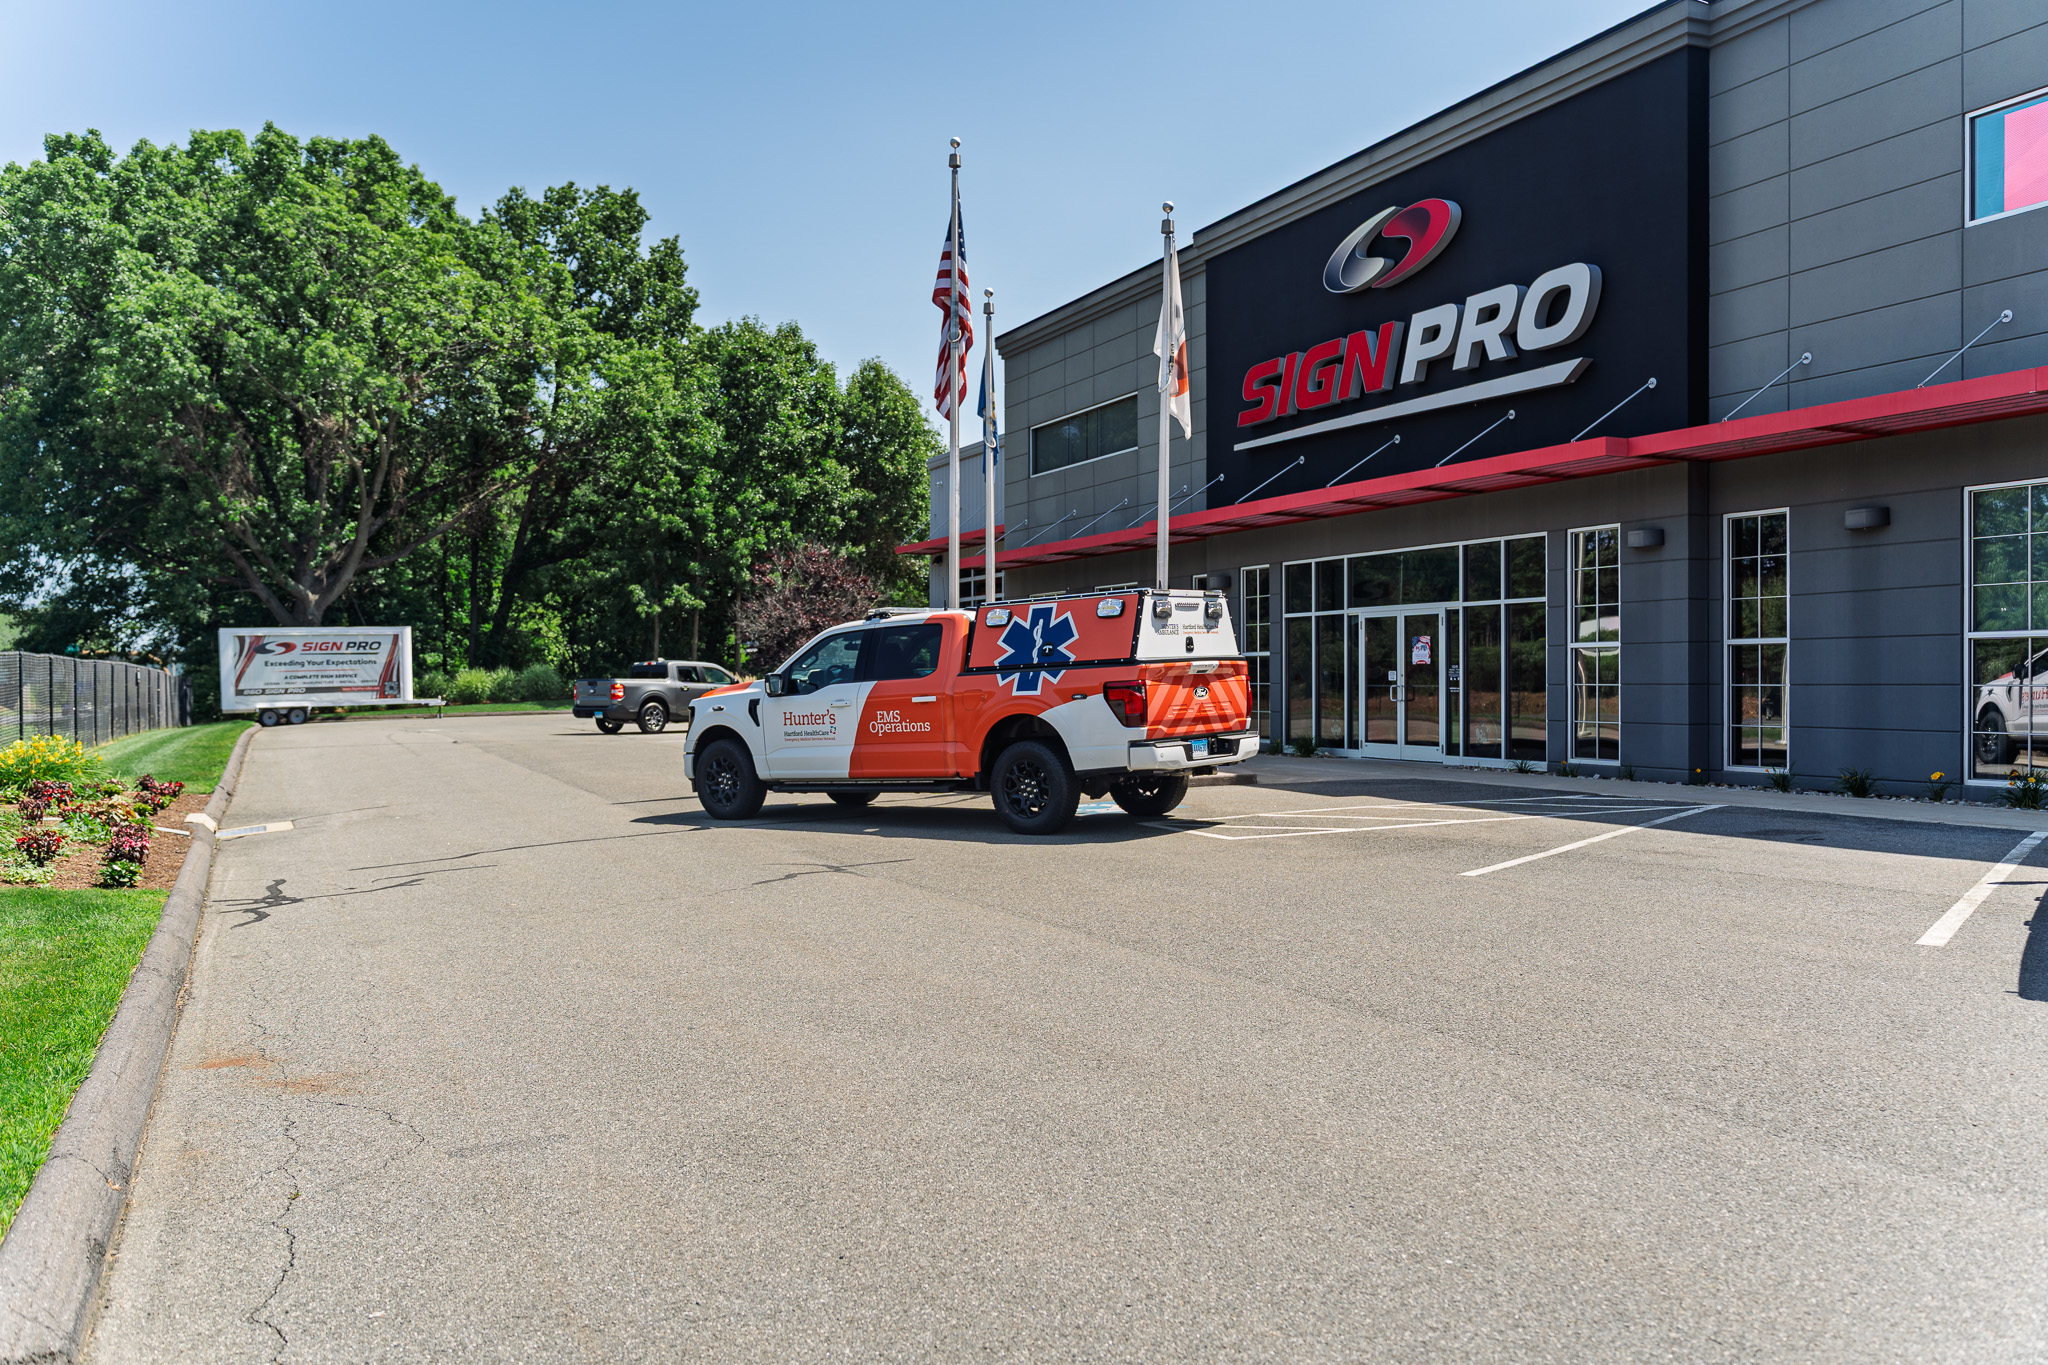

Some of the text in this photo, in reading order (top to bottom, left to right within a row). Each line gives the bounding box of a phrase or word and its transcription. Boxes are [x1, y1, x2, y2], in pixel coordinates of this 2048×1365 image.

[1237, 262, 1602, 428] SIGN PRO
[301, 641, 382, 652] SIGN PRO
[264, 660, 305, 668] Exceeding
[326, 659, 377, 668] Expectations
[783, 709, 836, 726] Hunter's
[876, 710, 900, 723] EMS
[869, 719, 931, 737] Operations
